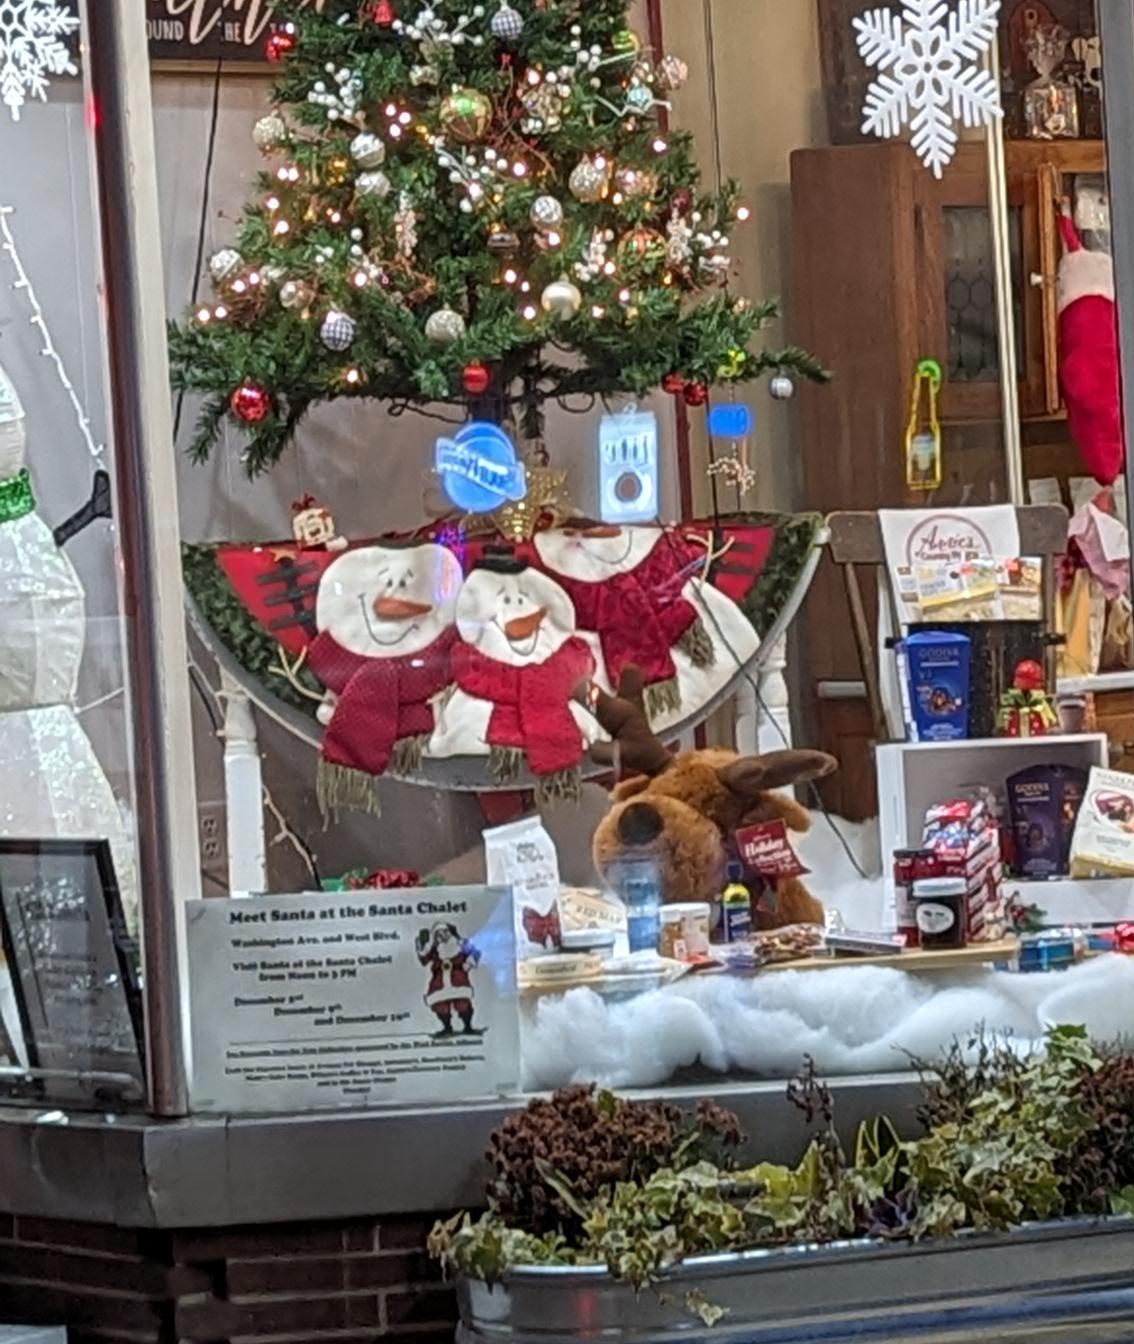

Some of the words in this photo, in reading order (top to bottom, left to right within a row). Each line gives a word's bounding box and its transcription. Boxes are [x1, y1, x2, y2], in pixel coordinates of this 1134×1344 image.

[229, 911, 267, 925] Meet
[270, 906, 316, 923] Santa
[319, 907, 336, 920] at
[339, 905, 365, 919] the
[368, 904, 413, 918] Santa
[416, 900, 467, 915] Chalet
[231, 937, 294, 949] Washington
[322, 934, 342, 944] and
[345, 932, 370, 943] West
[259, 959, 290, 970] Santa
[292, 959, 303, 968] at
[306, 957, 322, 968] the
[326, 956, 355, 967] Santa
[358, 954, 393, 966] Chalet
